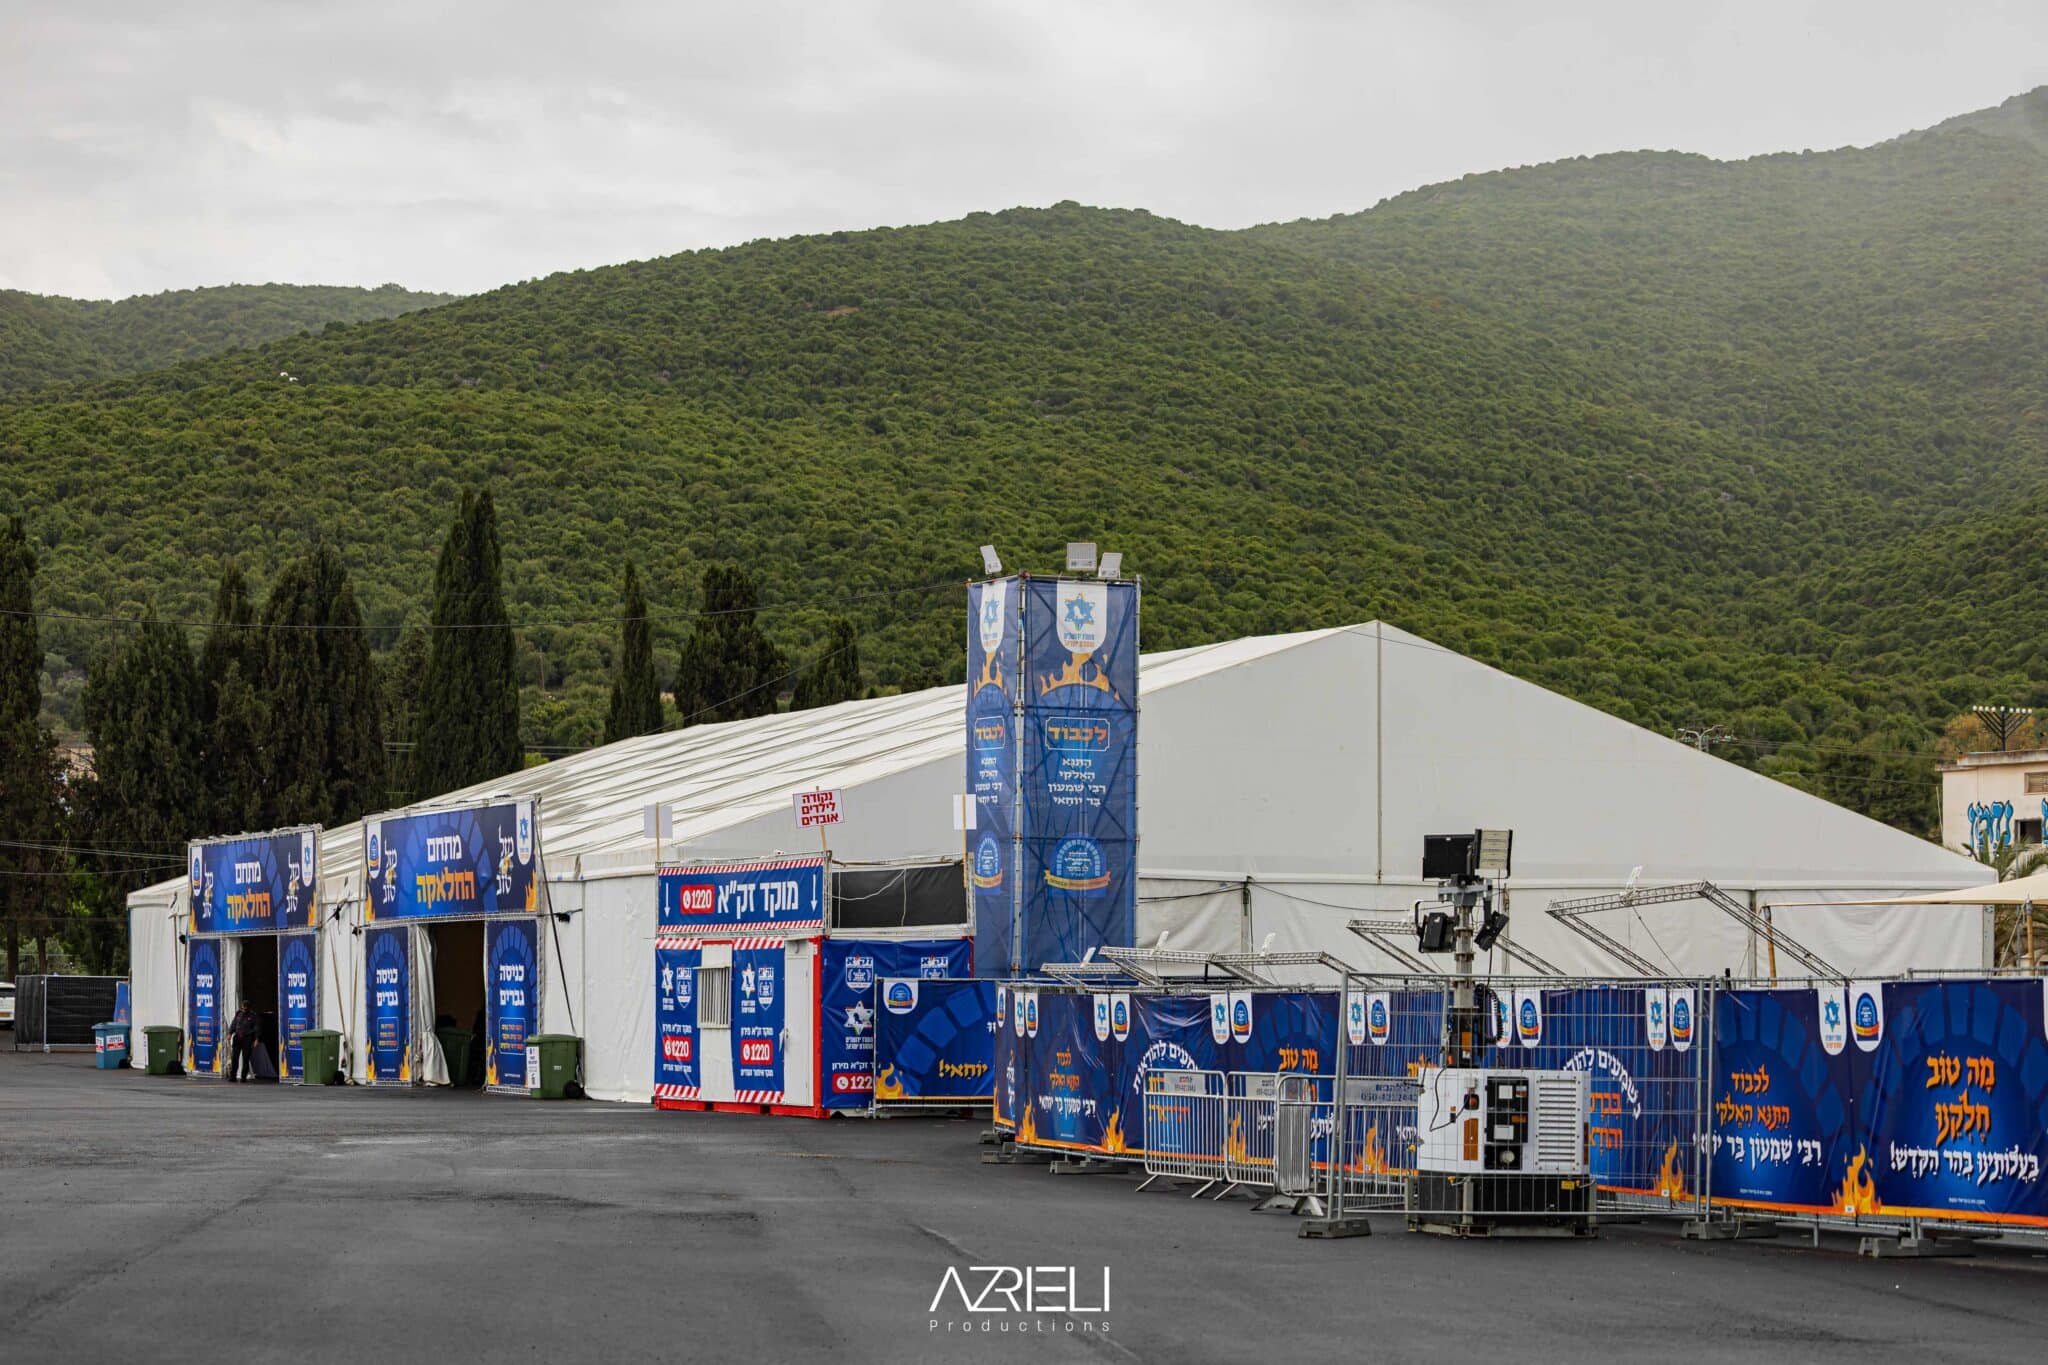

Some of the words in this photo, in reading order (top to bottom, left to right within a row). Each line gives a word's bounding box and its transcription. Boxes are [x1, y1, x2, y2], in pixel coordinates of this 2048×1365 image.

[1048, 726, 1107, 744] לכבוד
[801, 802, 836, 815] לילדים
[802, 792, 832, 804] נקודה
[801, 814, 839, 826] אובדים
[426, 834, 462, 862] מתחם
[235, 861, 261, 884] מתחם
[416, 866, 475, 909] החלאקה
[691, 889, 711, 909] 1220
[759, 881, 799, 918] מוקד
[227, 888, 270, 924] החלאקה
[288, 973, 306, 987] כניסה
[376, 968, 398, 984] כניסה
[499, 964, 524, 982] כניסה
[288, 994, 307, 1008] גברים
[376, 991, 399, 1007] גברים
[500, 988, 525, 1006] גברים
[672, 1040, 689, 1057] 1220
[750, 1044, 770, 1061] 1220
[1278, 1043, 1299, 1071] טוב
[1301, 1048, 1318, 1074] מה
[939, 1059, 988, 1079] יוחאי!
[1731, 1064, 1770, 1098] לכבוד
[1926, 1050, 1961, 1088] טוב
[1966, 1055, 1996, 1094] מה
[851, 1076, 873, 1089] 122
[1716, 1090, 1753, 1128] האלקי
[1757, 1104, 1790, 1131] התנא
[1935, 1088, 1991, 1147] חלקנו
[1726, 1136, 1745, 1162] בר
[1749, 1132, 1793, 1171] שמעון
[1797, 1139, 1822, 1166] רבי
[1890, 1140, 1939, 1179] הקדש!
[1943, 1149, 1974, 1181] בהר
[1976, 1144, 2040, 1186] בעלותינו
